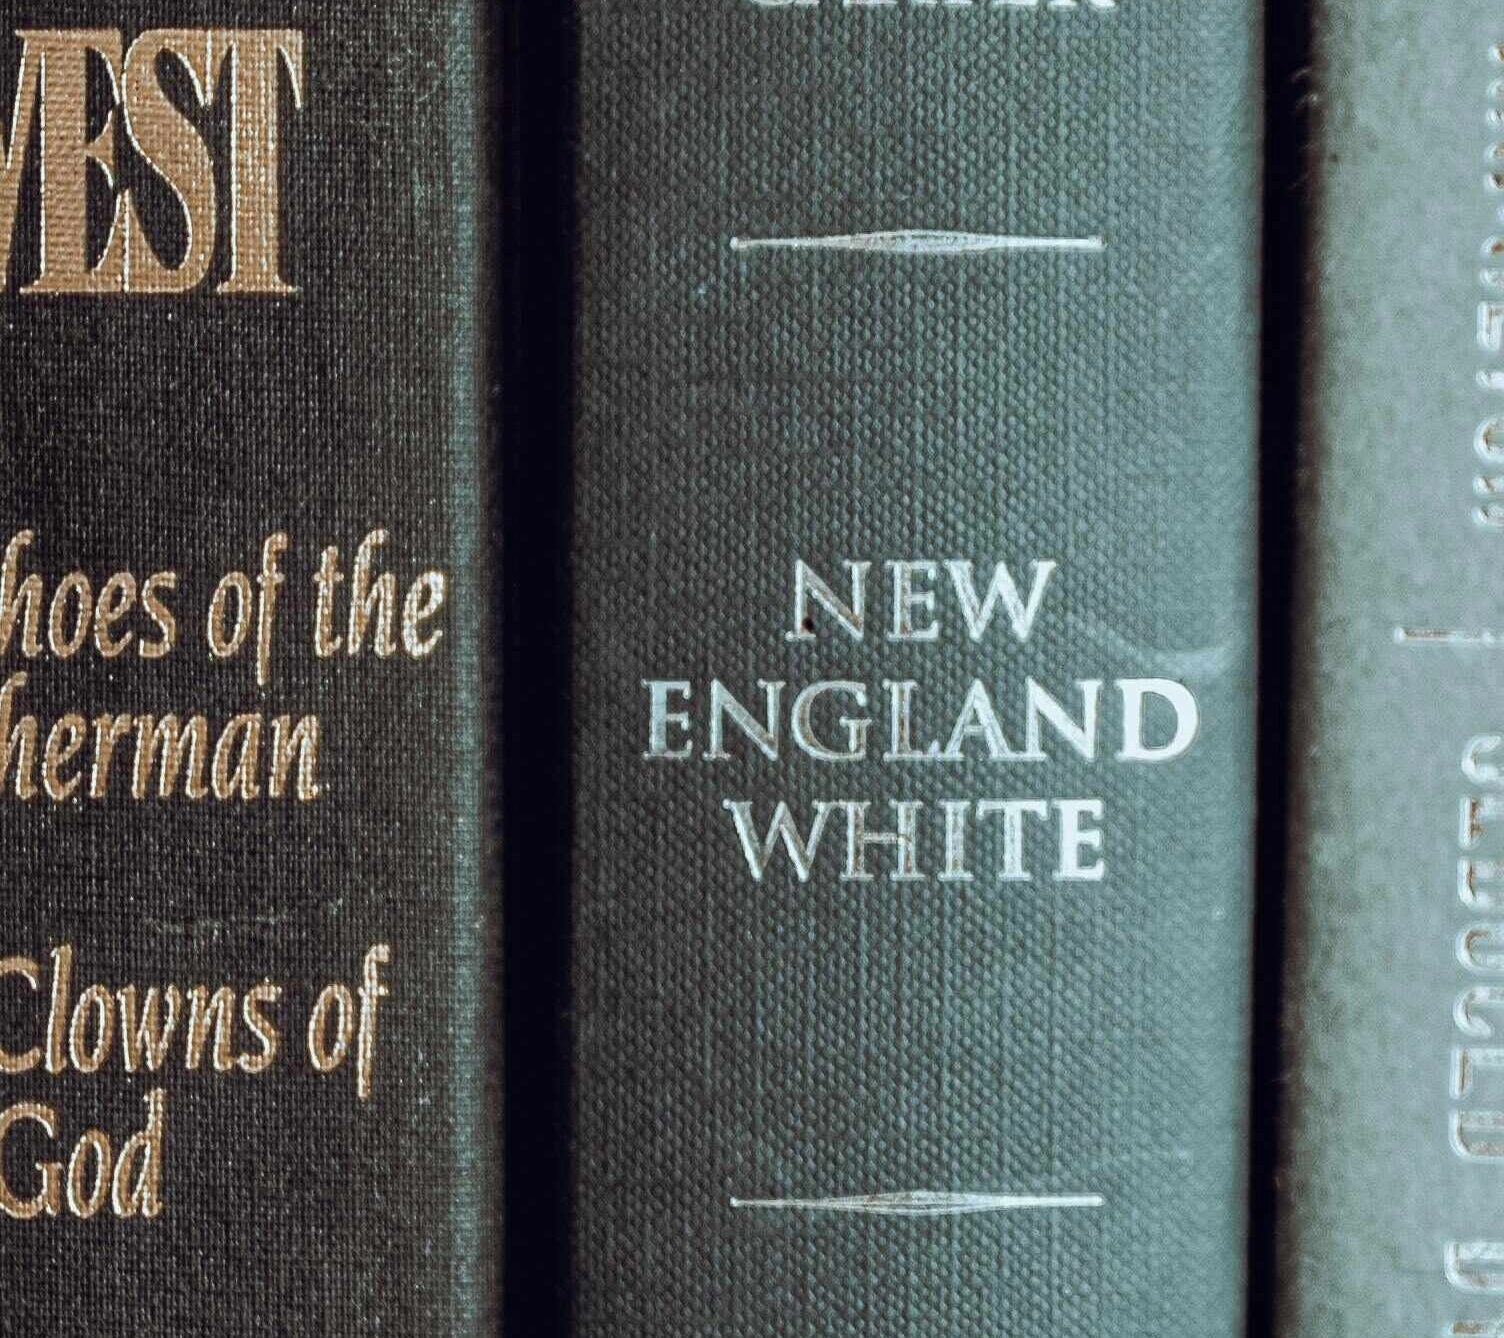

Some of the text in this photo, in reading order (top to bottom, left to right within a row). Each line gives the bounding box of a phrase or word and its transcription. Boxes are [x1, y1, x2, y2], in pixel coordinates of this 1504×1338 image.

[206, 529, 287, 687] of
[312, 528, 446, 659] the
[784, 557, 1058, 645] NEW
[640, 675, 1201, 766] ENGLAND
[722, 796, 1106, 884] WHITE
[306, 943, 391, 1101] of
